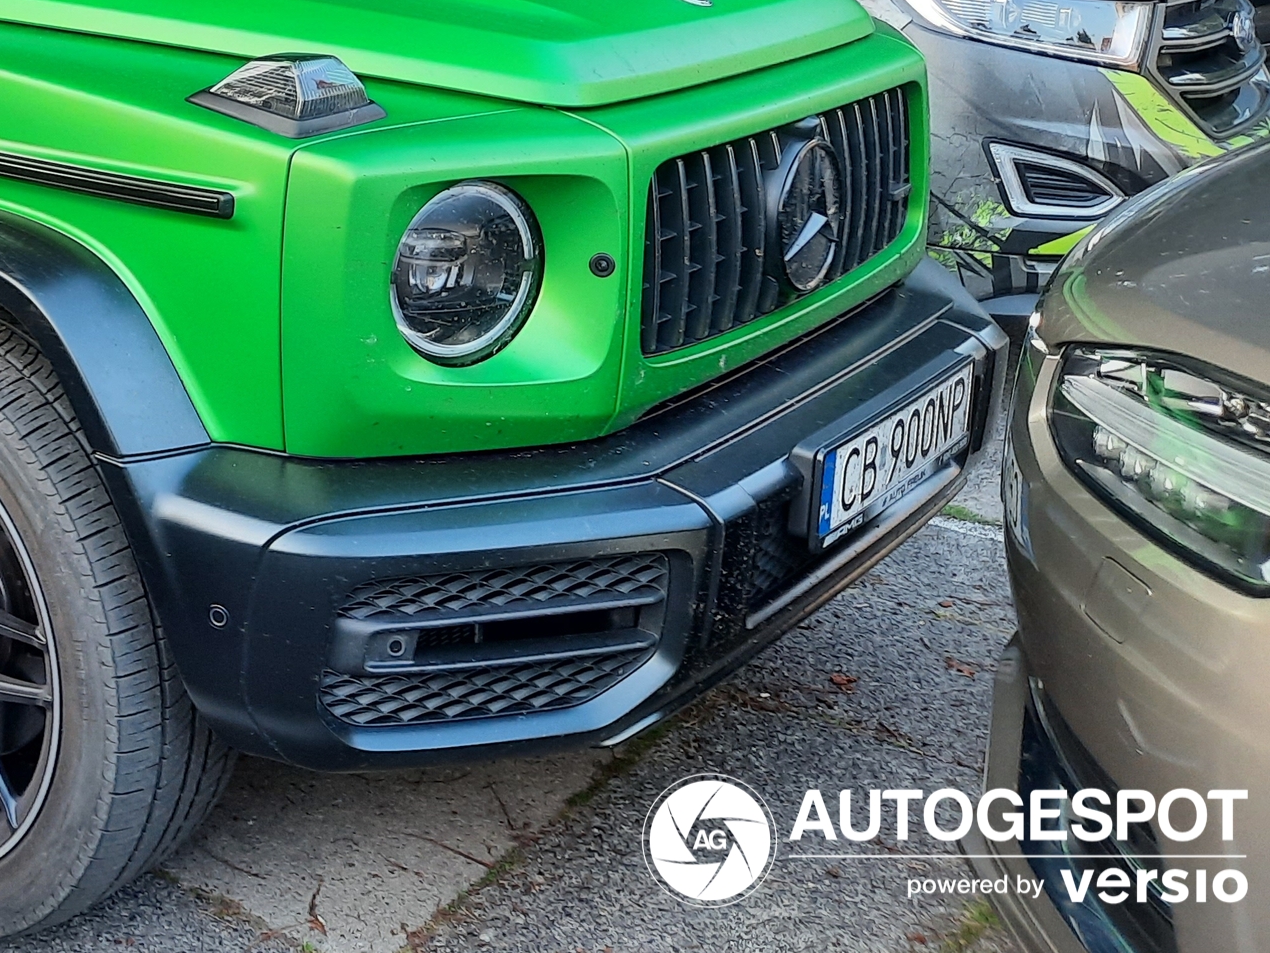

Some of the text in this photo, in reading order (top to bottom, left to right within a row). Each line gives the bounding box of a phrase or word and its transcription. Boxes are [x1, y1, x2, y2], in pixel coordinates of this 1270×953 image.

[840, 376, 966, 511] CB 900NP
[819, 504, 830, 523] PL
